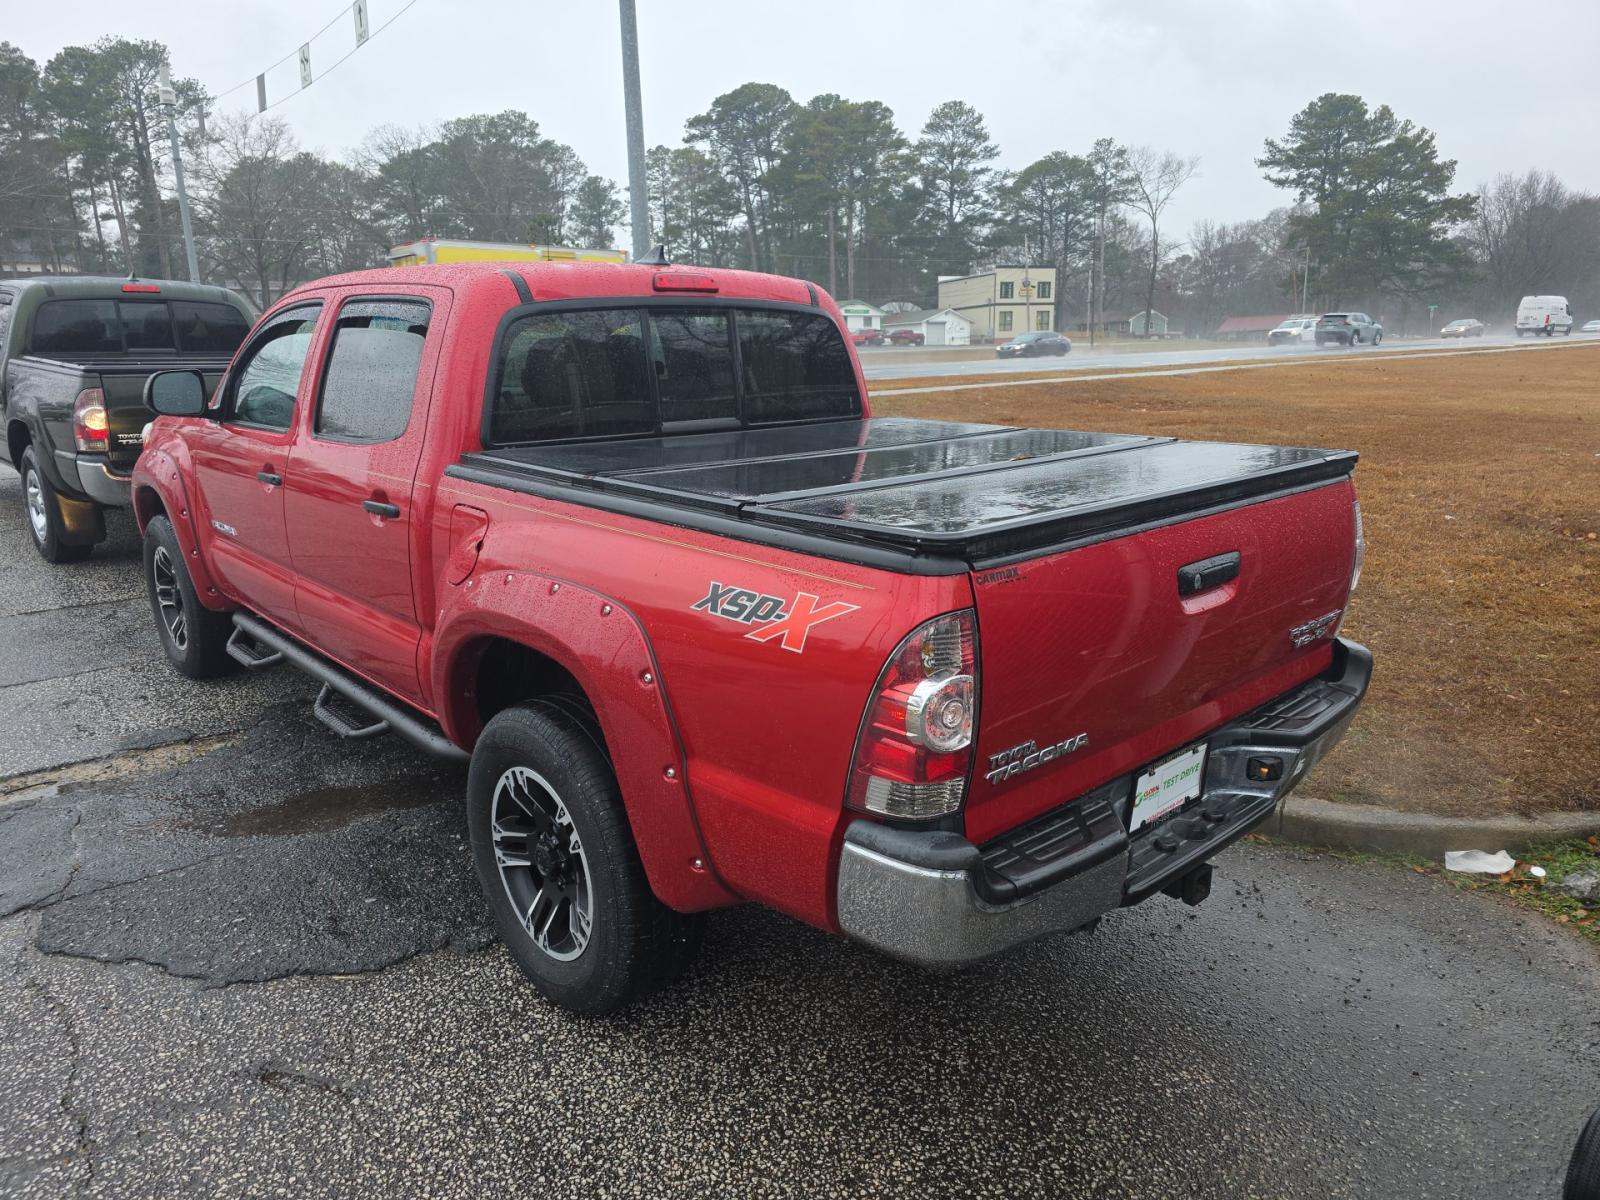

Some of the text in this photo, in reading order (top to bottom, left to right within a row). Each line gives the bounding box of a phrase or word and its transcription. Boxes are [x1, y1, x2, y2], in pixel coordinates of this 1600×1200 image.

[984, 732, 1089, 785] TACOMA
[989, 740, 1037, 770] TOYOTA
[1163, 762, 1200, 790] TEST DRIVE
